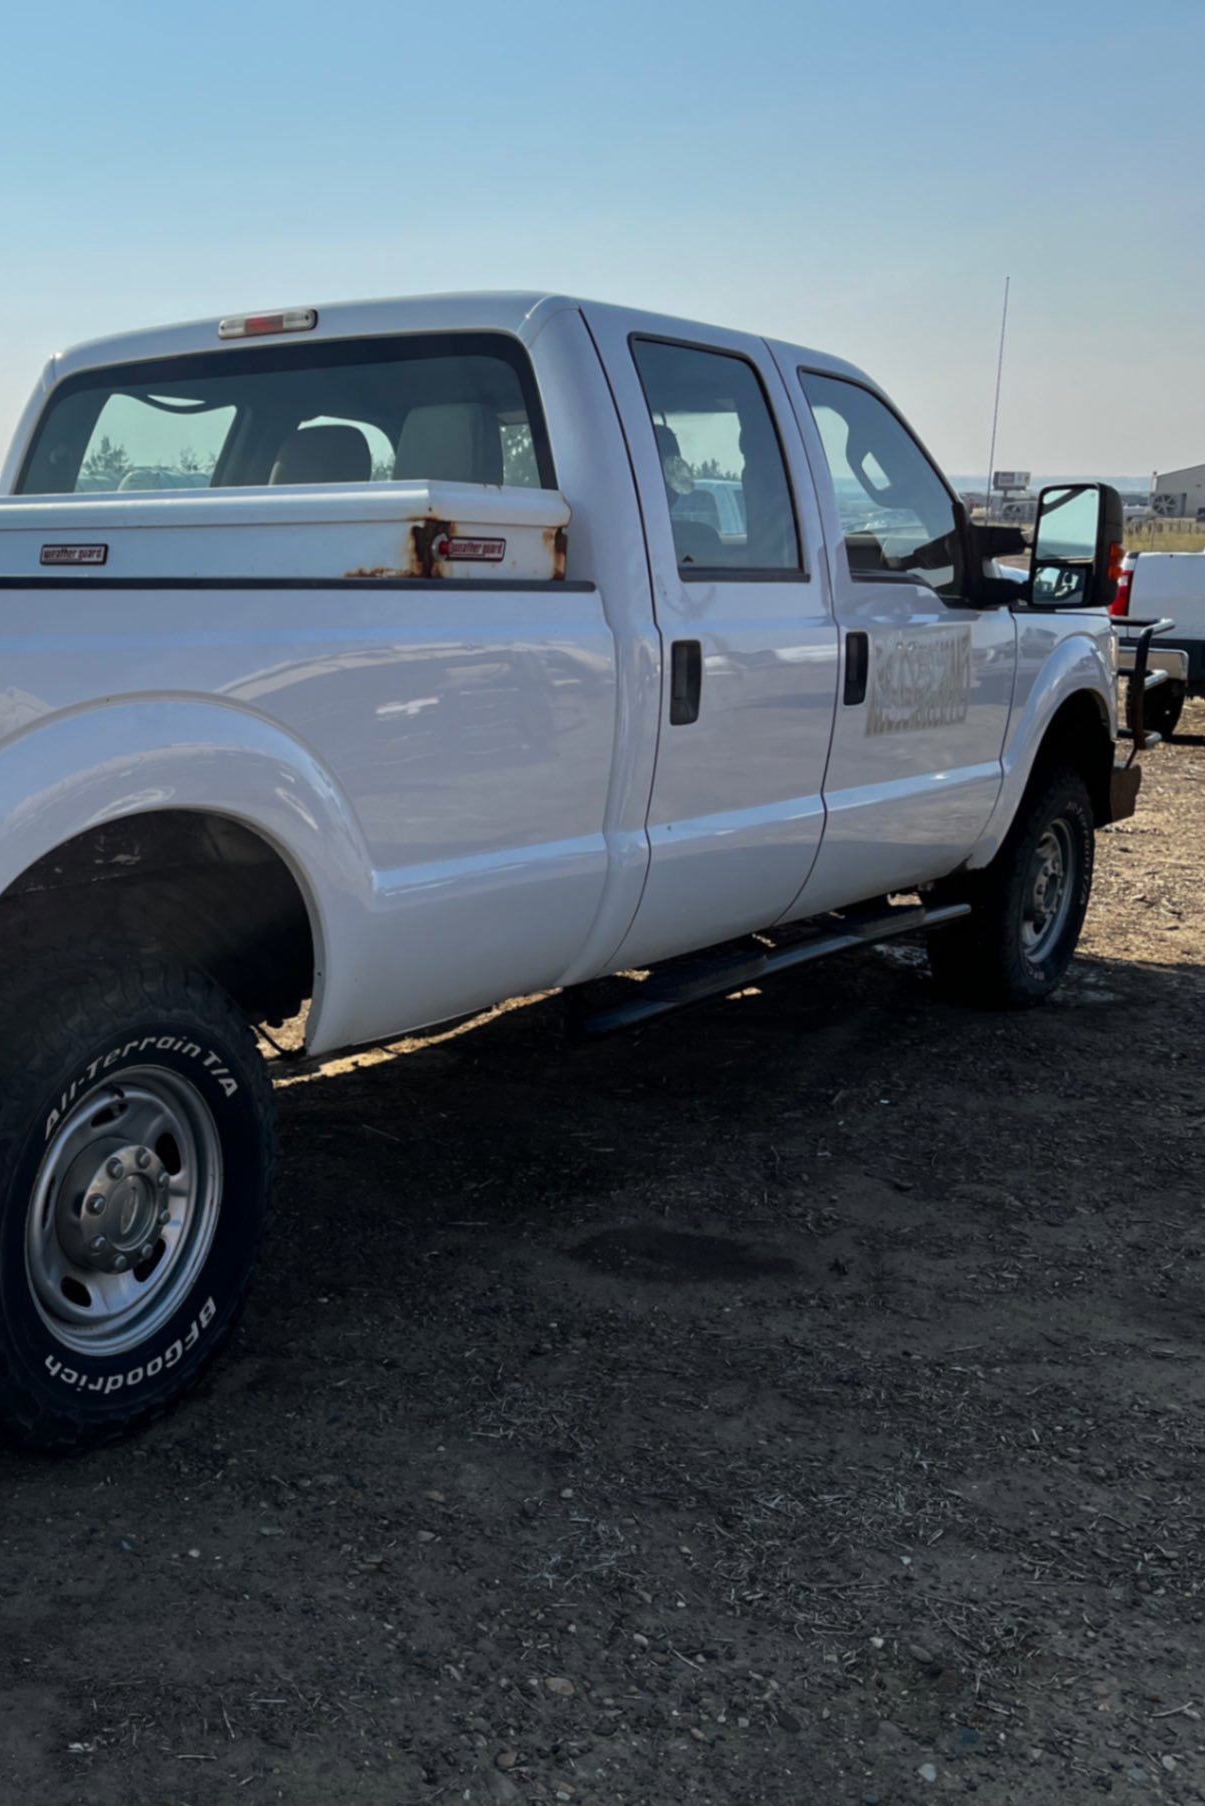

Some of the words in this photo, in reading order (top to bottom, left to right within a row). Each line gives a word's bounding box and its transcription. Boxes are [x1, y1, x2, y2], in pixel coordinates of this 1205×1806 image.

[44, 549, 76, 559] weather
[78, 548, 102, 560] guard
[483, 543, 503, 555] guard
[44, 1035, 202, 1141] All-Terrain
[202, 1050, 238, 1098] T/A
[44, 1296, 217, 1395] BFGoodrich
